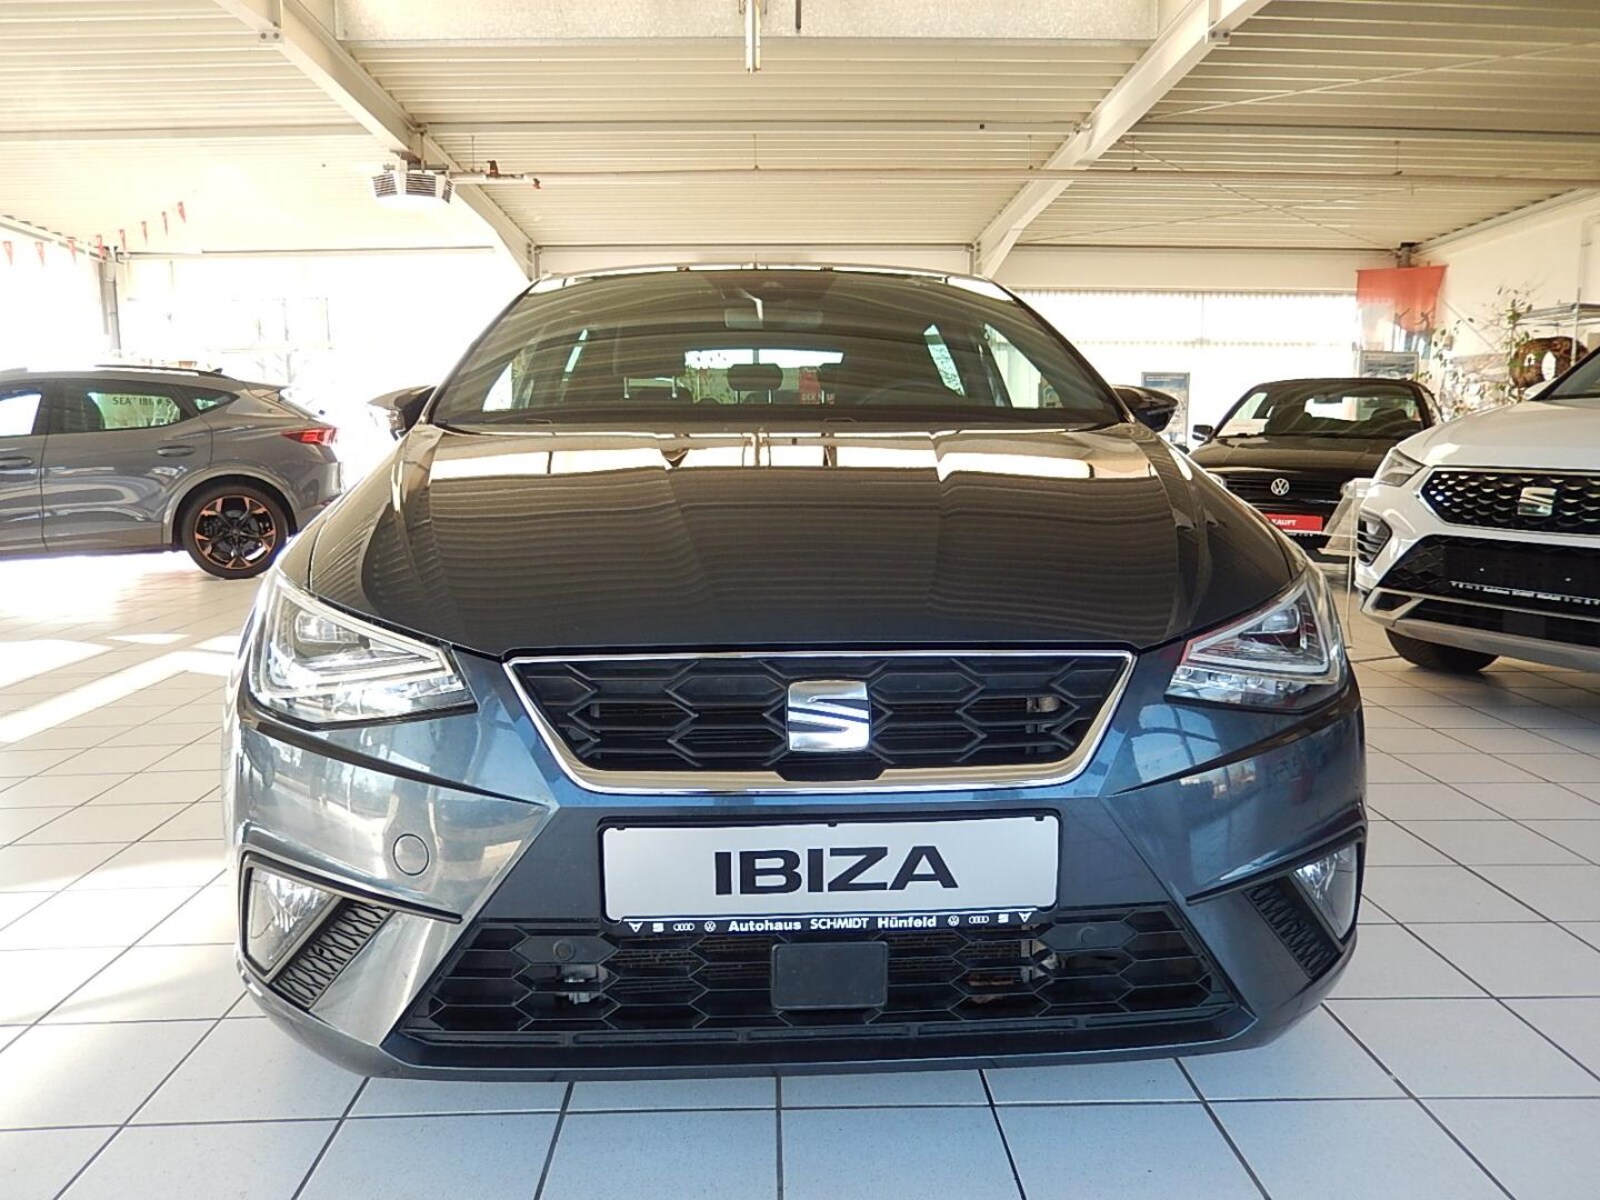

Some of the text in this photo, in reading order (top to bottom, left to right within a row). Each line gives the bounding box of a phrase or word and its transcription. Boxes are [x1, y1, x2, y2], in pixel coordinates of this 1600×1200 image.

[714, 845, 959, 895] IBIZA
[728, 919, 801, 932] Autohaus
[809, 917, 870, 930] SCHMIDT
[877, 915, 937, 928] Hünfeld
